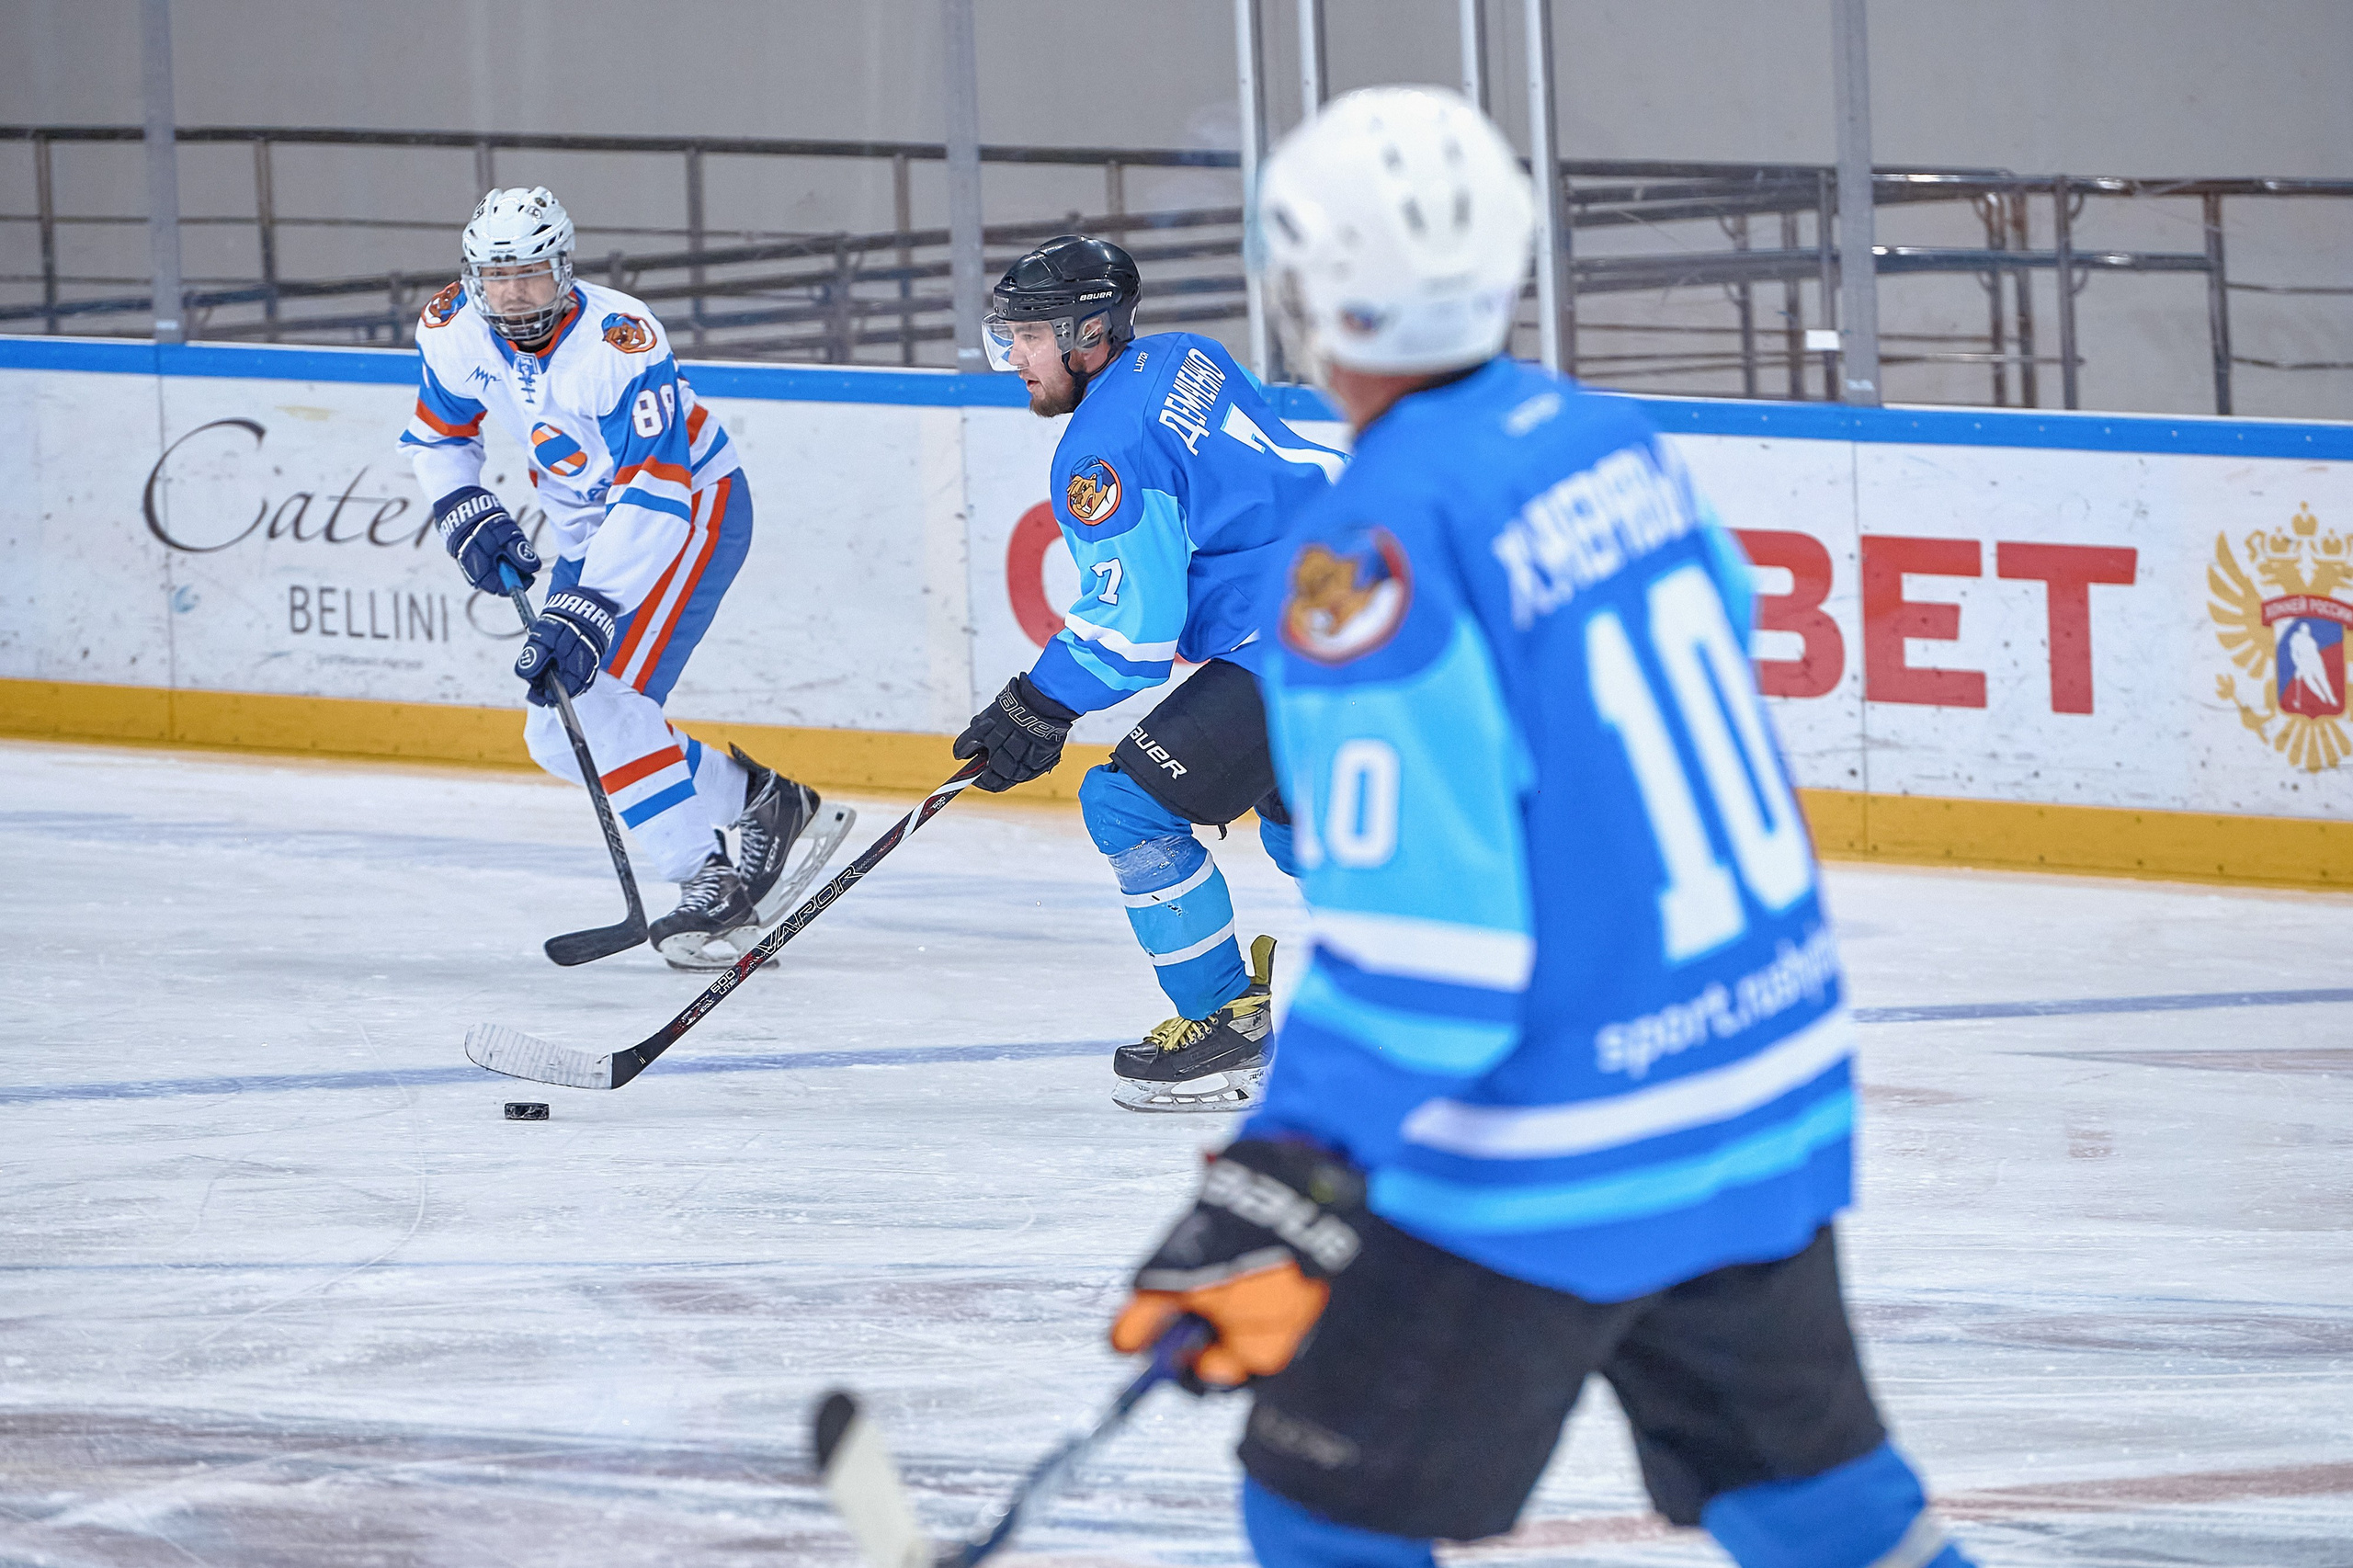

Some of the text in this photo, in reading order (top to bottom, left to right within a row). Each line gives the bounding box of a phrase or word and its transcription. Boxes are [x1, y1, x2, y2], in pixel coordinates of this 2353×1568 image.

[1079, 290, 1113, 301] BAUER
[438, 493, 501, 540] ARRIO
[1090, 557, 1124, 606] 7
[288, 585, 450, 642] BELLINI
[543, 592, 615, 645] WARRIO
[1129, 725, 1188, 780] AUER
[1585, 562, 1822, 965] 10
[755, 864, 864, 955] VAPOR
[710, 969, 736, 994] 600
